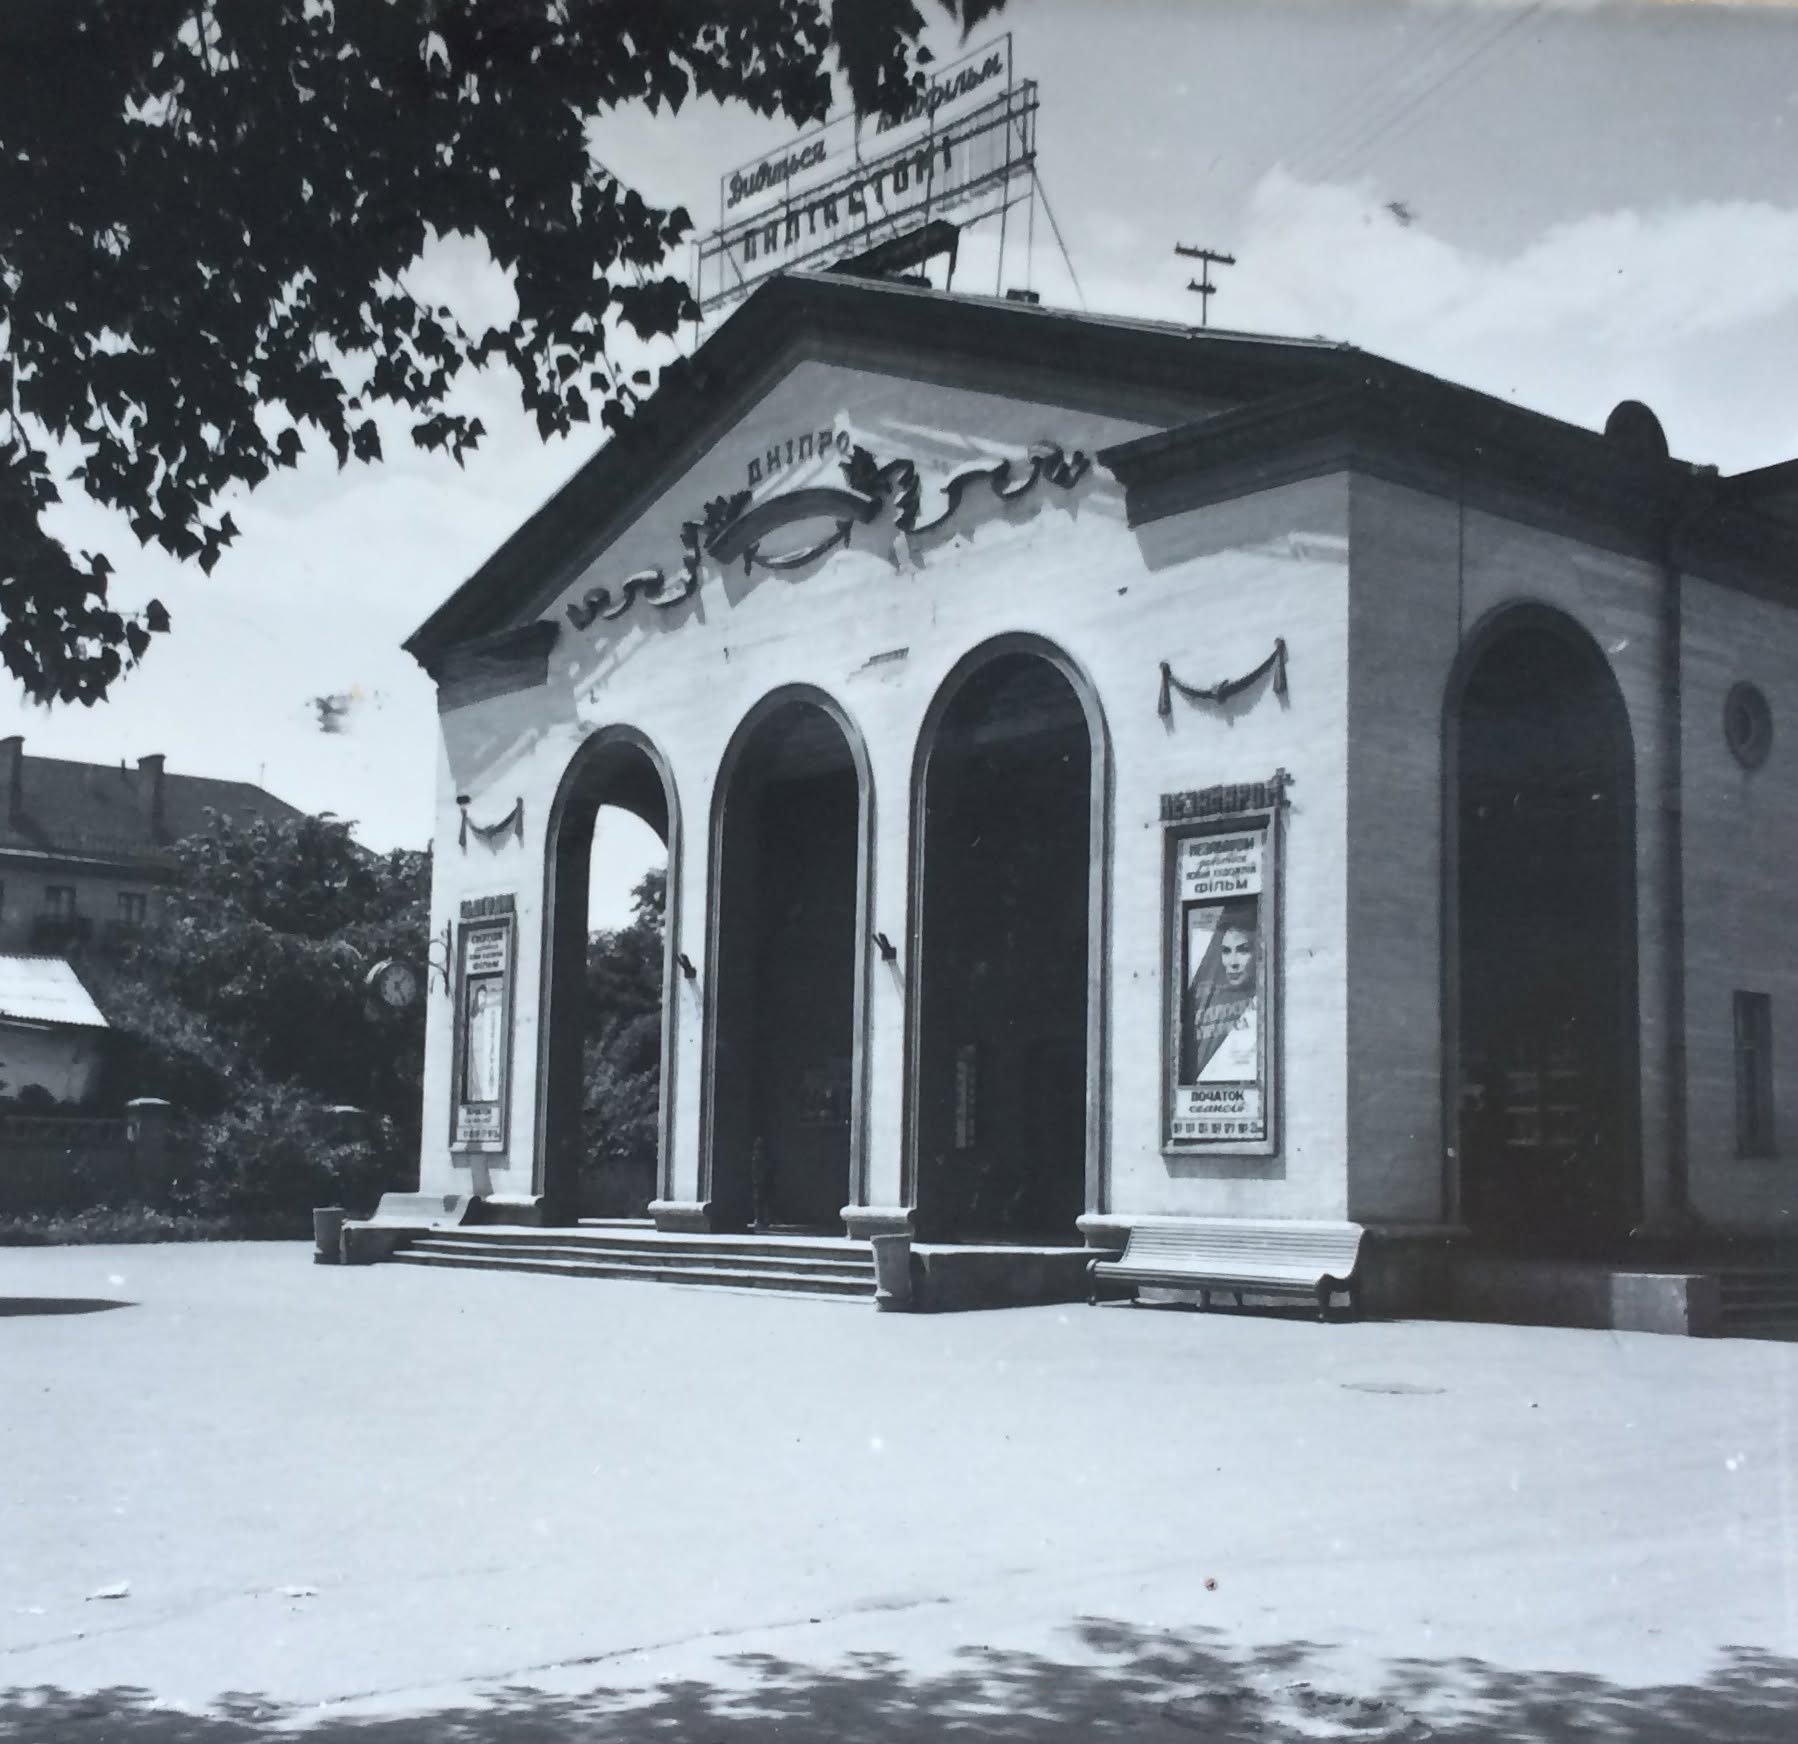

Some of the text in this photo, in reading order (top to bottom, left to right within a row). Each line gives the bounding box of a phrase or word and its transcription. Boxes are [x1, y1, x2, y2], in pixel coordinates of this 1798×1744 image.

[747, 429, 850, 487] ДНІПРО
[1194, 879, 1248, 893] ФІЛЬМ
[1191, 1090, 1244, 1102] ПОЧАТОК
